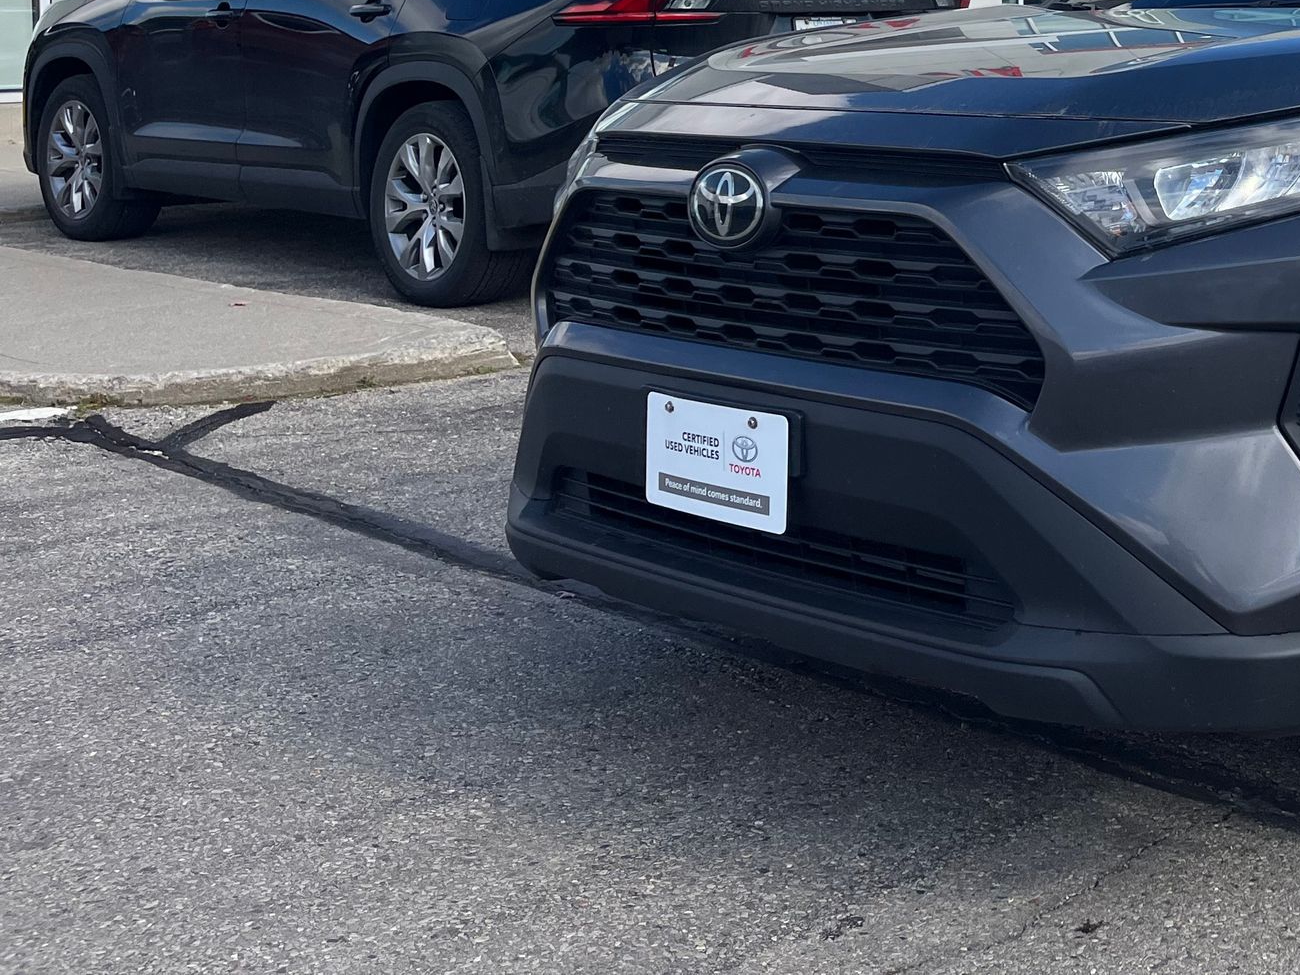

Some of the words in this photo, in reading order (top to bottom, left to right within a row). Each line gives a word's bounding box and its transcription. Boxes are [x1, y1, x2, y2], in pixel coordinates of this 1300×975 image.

[682, 431, 720, 447] CERTIFIED
[665, 439, 683, 453] USED
[684, 445, 720, 460] VEHICLES
[729, 463, 761, 478] TOYOTA
[665, 478, 682, 490] Peace
[683, 482, 690, 491] of
[690, 485, 707, 496] mind
[707, 490, 729, 501] comes
[729, 494, 762, 508] standard.
